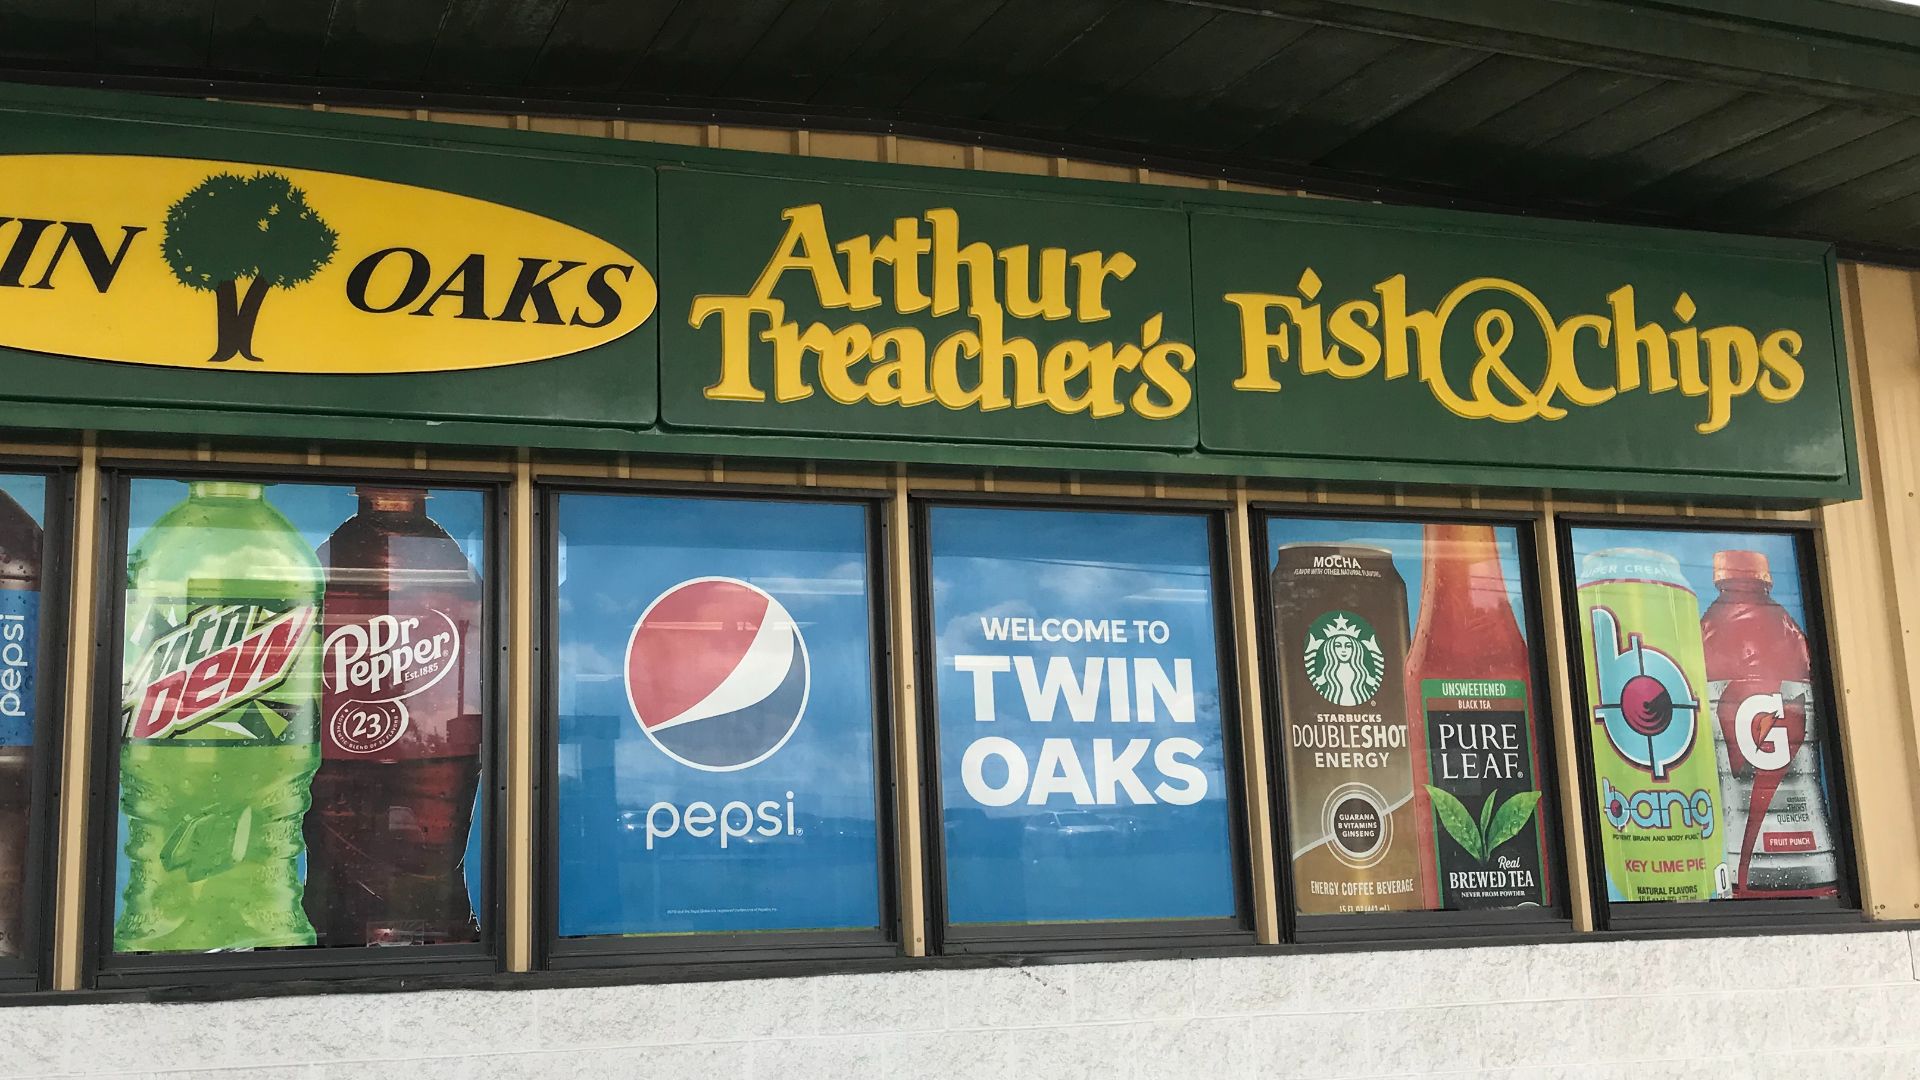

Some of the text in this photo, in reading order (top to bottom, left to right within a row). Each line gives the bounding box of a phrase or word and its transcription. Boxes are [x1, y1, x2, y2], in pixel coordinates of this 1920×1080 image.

[0, 216, 634, 328] IN OAKS
[749, 203, 1137, 323] Arthur
[688, 294, 1196, 420] Treacher's
[1223, 266, 1438, 392] Fish
[1552, 283, 1805, 435] Chips
[1313, 556, 1361, 569] MOCHA
[368, 614, 419, 656] Dr
[980, 616, 1170, 644] WELCOME TO
[0, 615, 28, 717] pepsi
[323, 624, 450, 695] Pepper
[954, 655, 1196, 723] TWIN
[1441, 682, 1506, 696] UNSWEETENED
[1458, 699, 1491, 709] BLACK TEA
[352, 711, 381, 739] 23
[1317, 713, 1382, 723] STARBUCKS
[1292, 724, 1407, 749] DOUBLESHOT
[1438, 723, 1519, 750] PURE
[1734, 693, 1791, 771] G
[961, 736, 1208, 807] OAKS
[1314, 752, 1390, 768] ENERGY
[1440, 752, 1520, 779] LEAF
[646, 790, 795, 850] pepsi
[1339, 813, 1375, 821] GUARANA
[1602, 776, 1714, 840] bang
[1342, 830, 1375, 838] GINSENG
[1769, 837, 1810, 847] FRUIT PUNCH
[1497, 855, 1520, 870] Real
[1625, 858, 1706, 873] KEY LIME PIE
[1310, 879, 1414, 896] ENERGY COFFEE BEVERAGE
[1449, 870, 1534, 889] BREWED TEA
[1637, 884, 1698, 896] NATURAL FLAVORS
